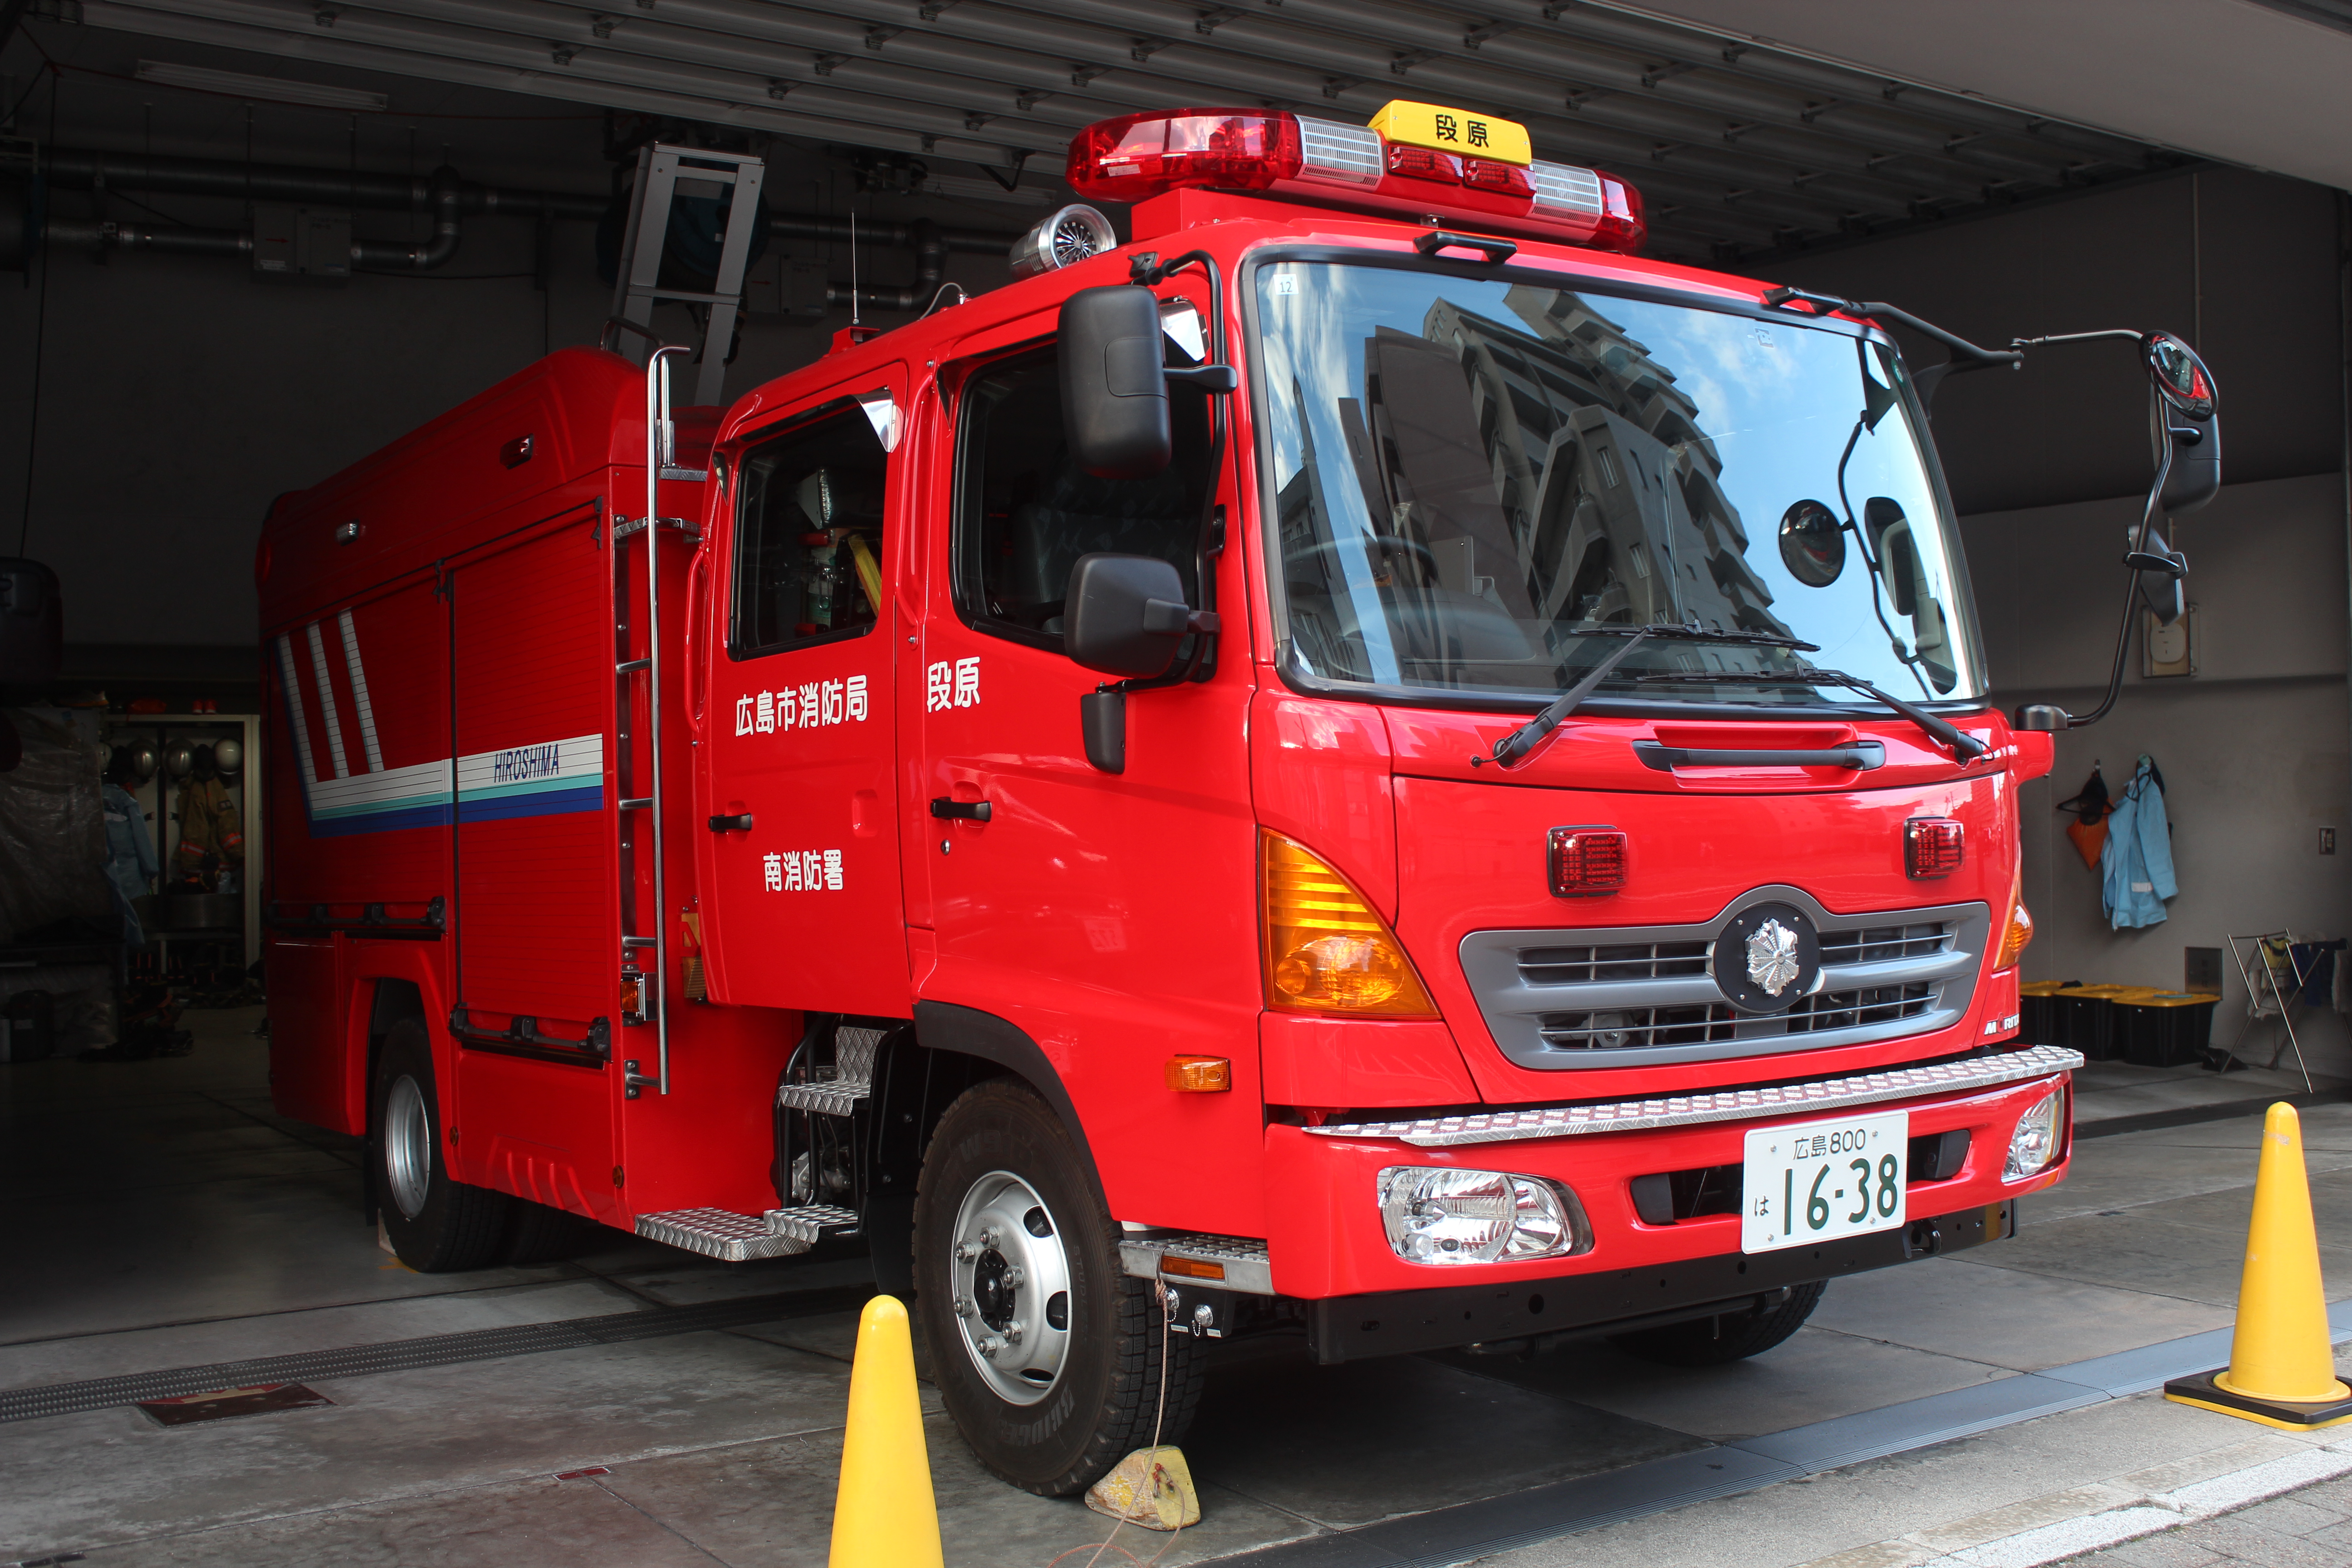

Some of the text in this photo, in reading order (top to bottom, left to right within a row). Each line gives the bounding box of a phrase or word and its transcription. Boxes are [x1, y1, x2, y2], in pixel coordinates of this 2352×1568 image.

[1436, 114, 1489, 148] 段原
[1280, 281, 1293, 293] 12
[735, 675, 867, 736] 広島市消防局
[927, 657, 980, 713] 段原
[494, 744, 559, 783] HIROSHIMA
[763, 849, 843, 892] 南消防署
[1754, 1153, 1897, 1235] は 16-38
